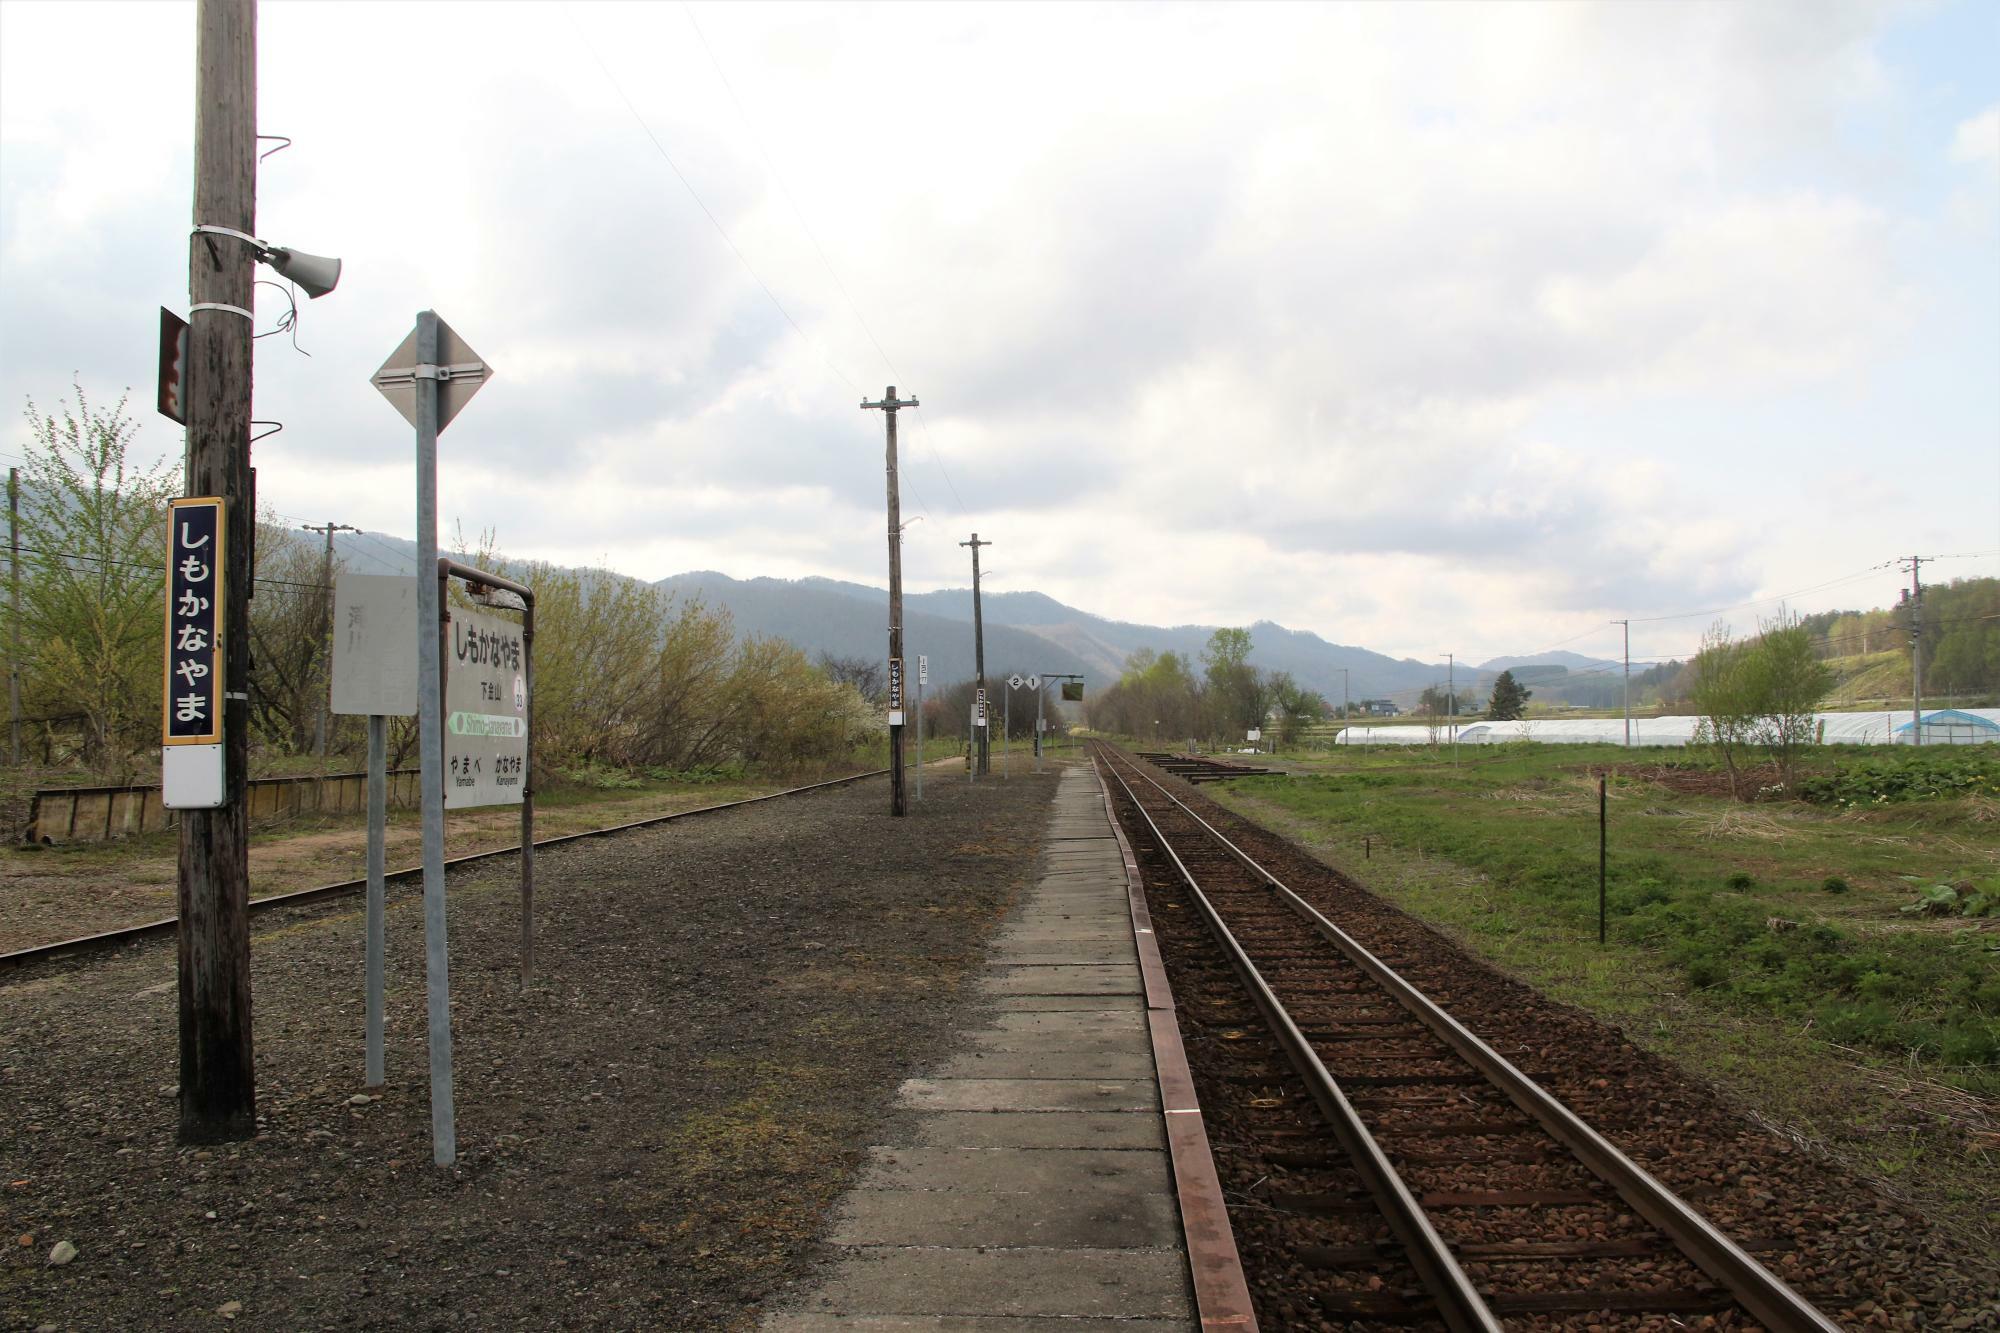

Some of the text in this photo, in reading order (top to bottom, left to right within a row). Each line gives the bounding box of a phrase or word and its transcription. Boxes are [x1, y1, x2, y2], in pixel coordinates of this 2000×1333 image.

[176, 521, 209, 722] しもかなやま
[455, 620, 520, 672] しもかなやま
[481, 681, 502, 702] 下金山
[891, 663, 900, 708] しもかなやま
[1013, 677, 1020, 686] 2
[1031, 678, 1035, 686] 1
[451, 756, 522, 775] やまべ かなやま
[456, 776, 518, 788] Yamabe Kanayama
